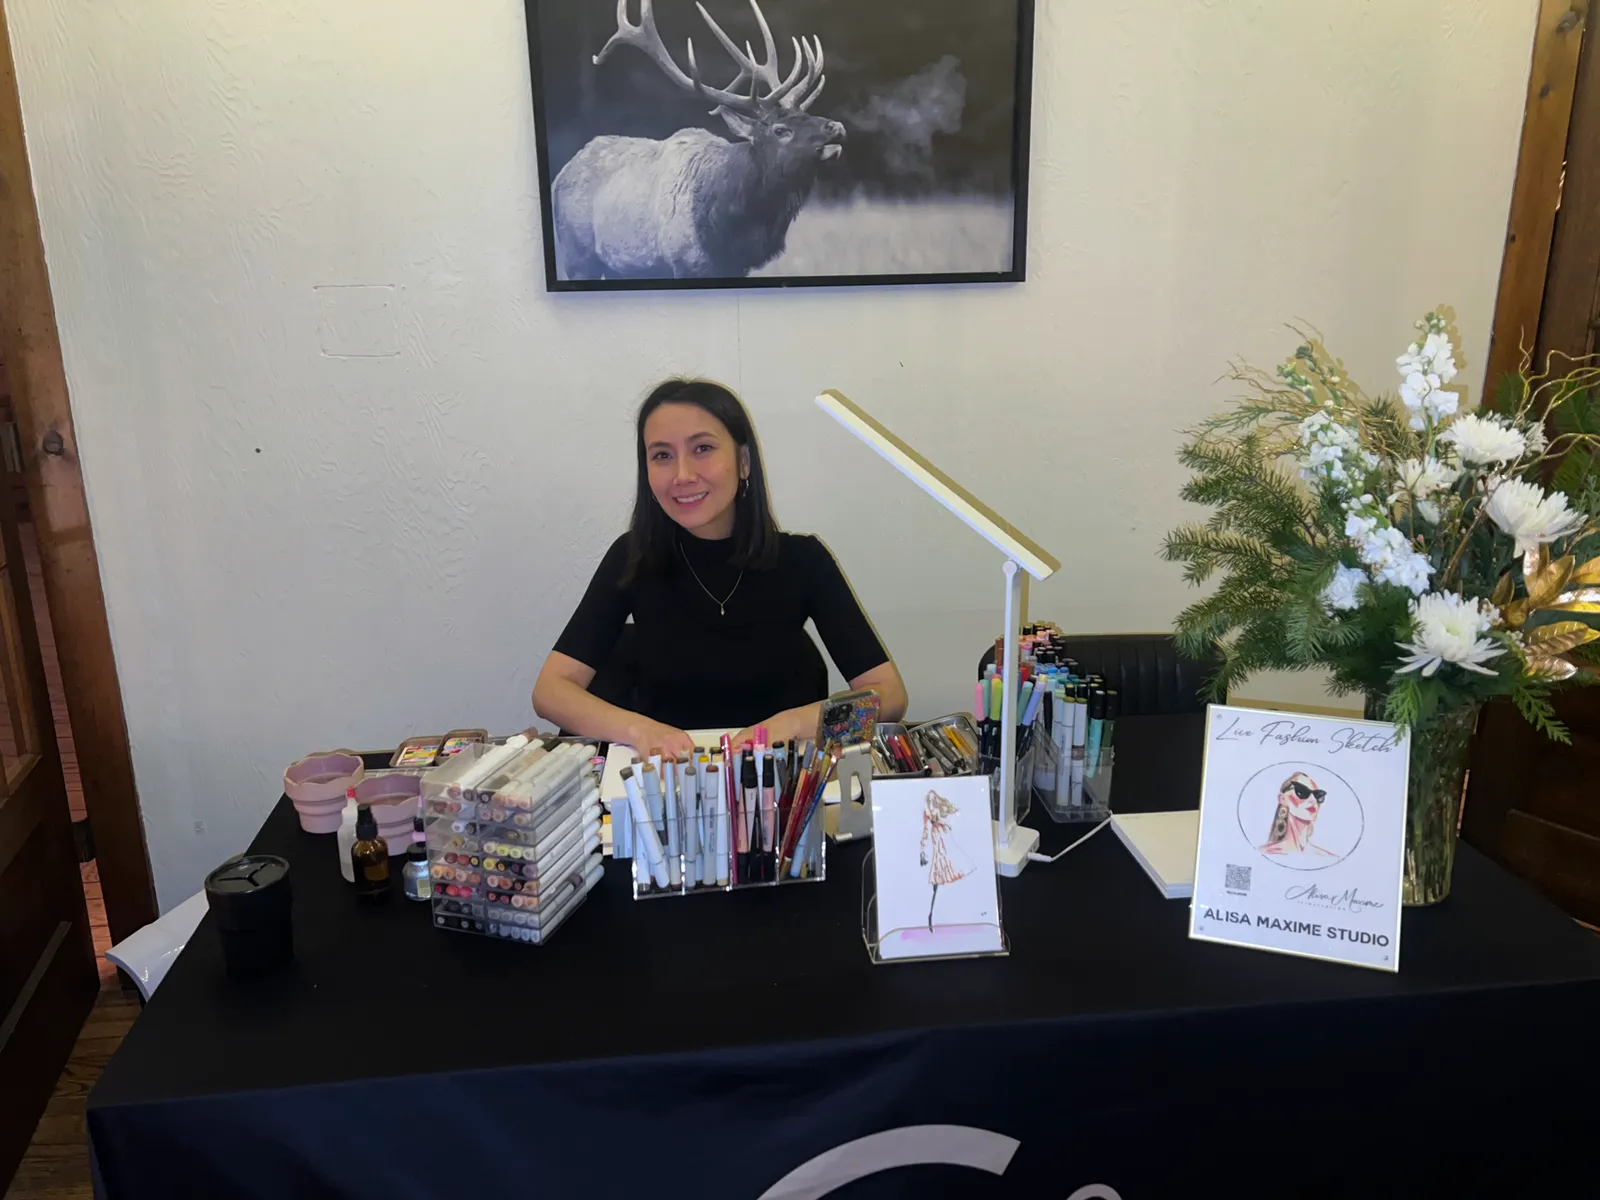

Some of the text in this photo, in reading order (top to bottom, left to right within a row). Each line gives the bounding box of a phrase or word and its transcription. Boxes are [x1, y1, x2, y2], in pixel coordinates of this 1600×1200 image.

[1216, 717, 1393, 754] Live Fashion Sketch
[1203, 907, 1390, 947] ALISA MAXIME STUDIO
